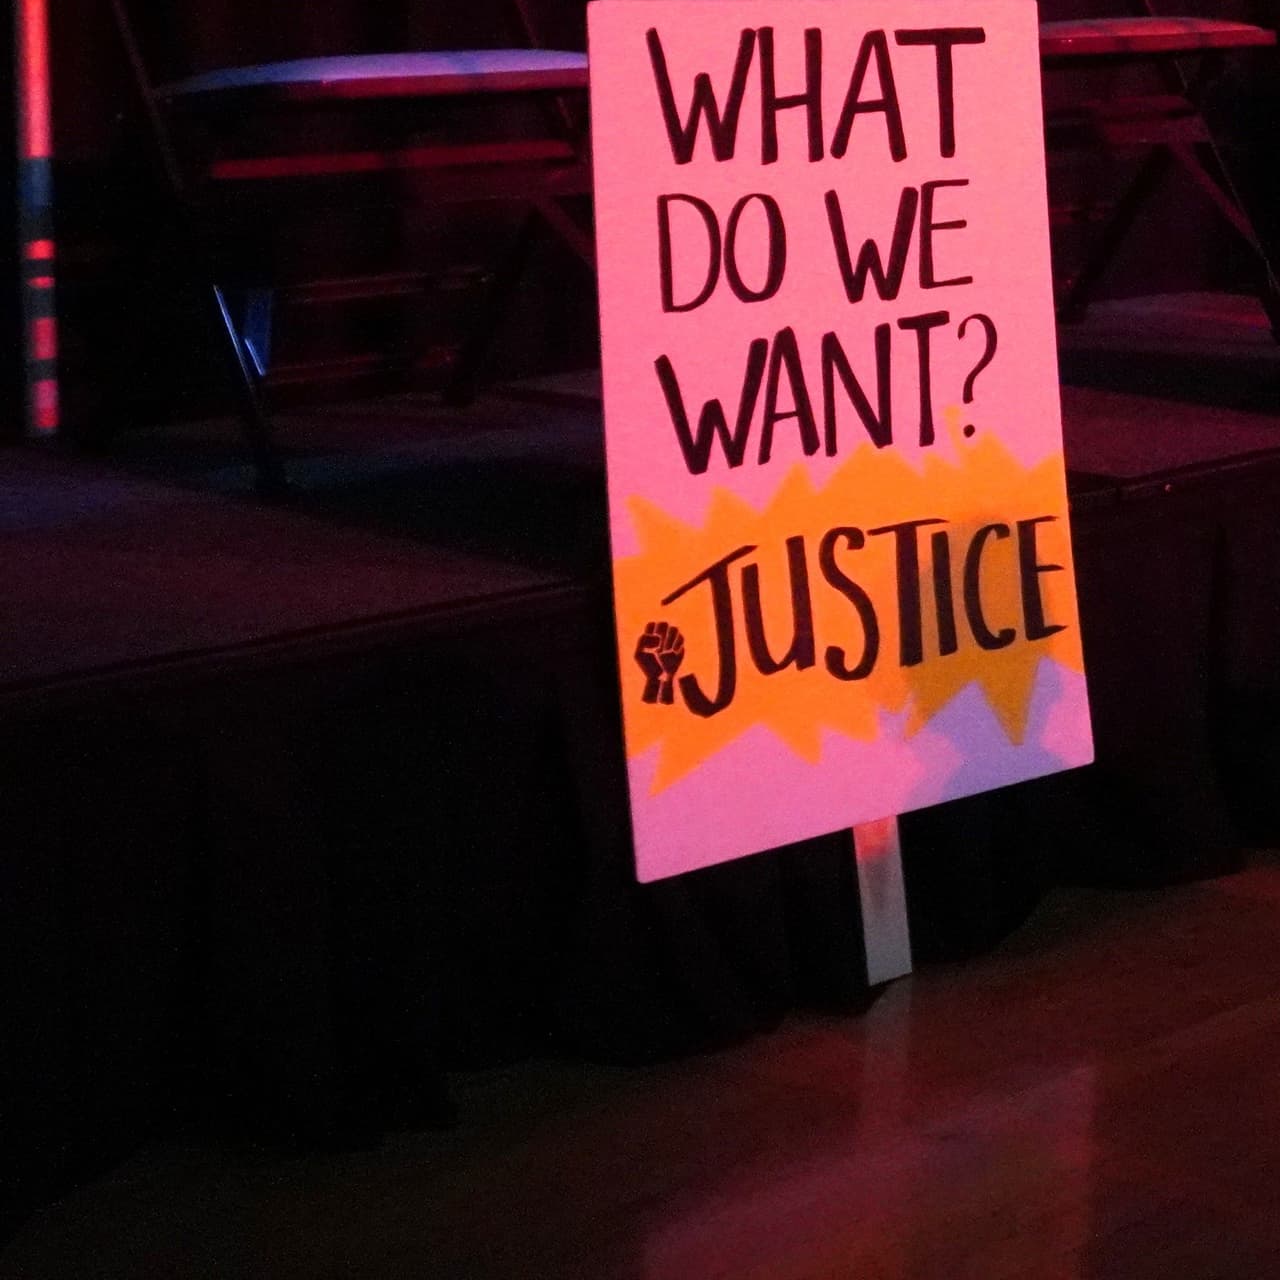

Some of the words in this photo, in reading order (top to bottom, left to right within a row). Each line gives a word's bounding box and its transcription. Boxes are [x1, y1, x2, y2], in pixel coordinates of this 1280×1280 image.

[646, 26, 986, 165] WHAT
[656, 192, 788, 314] DO
[824, 178, 974, 304] WE
[653, 310, 998, 476] WANT?
[660, 515, 1069, 719] JUSTICE
